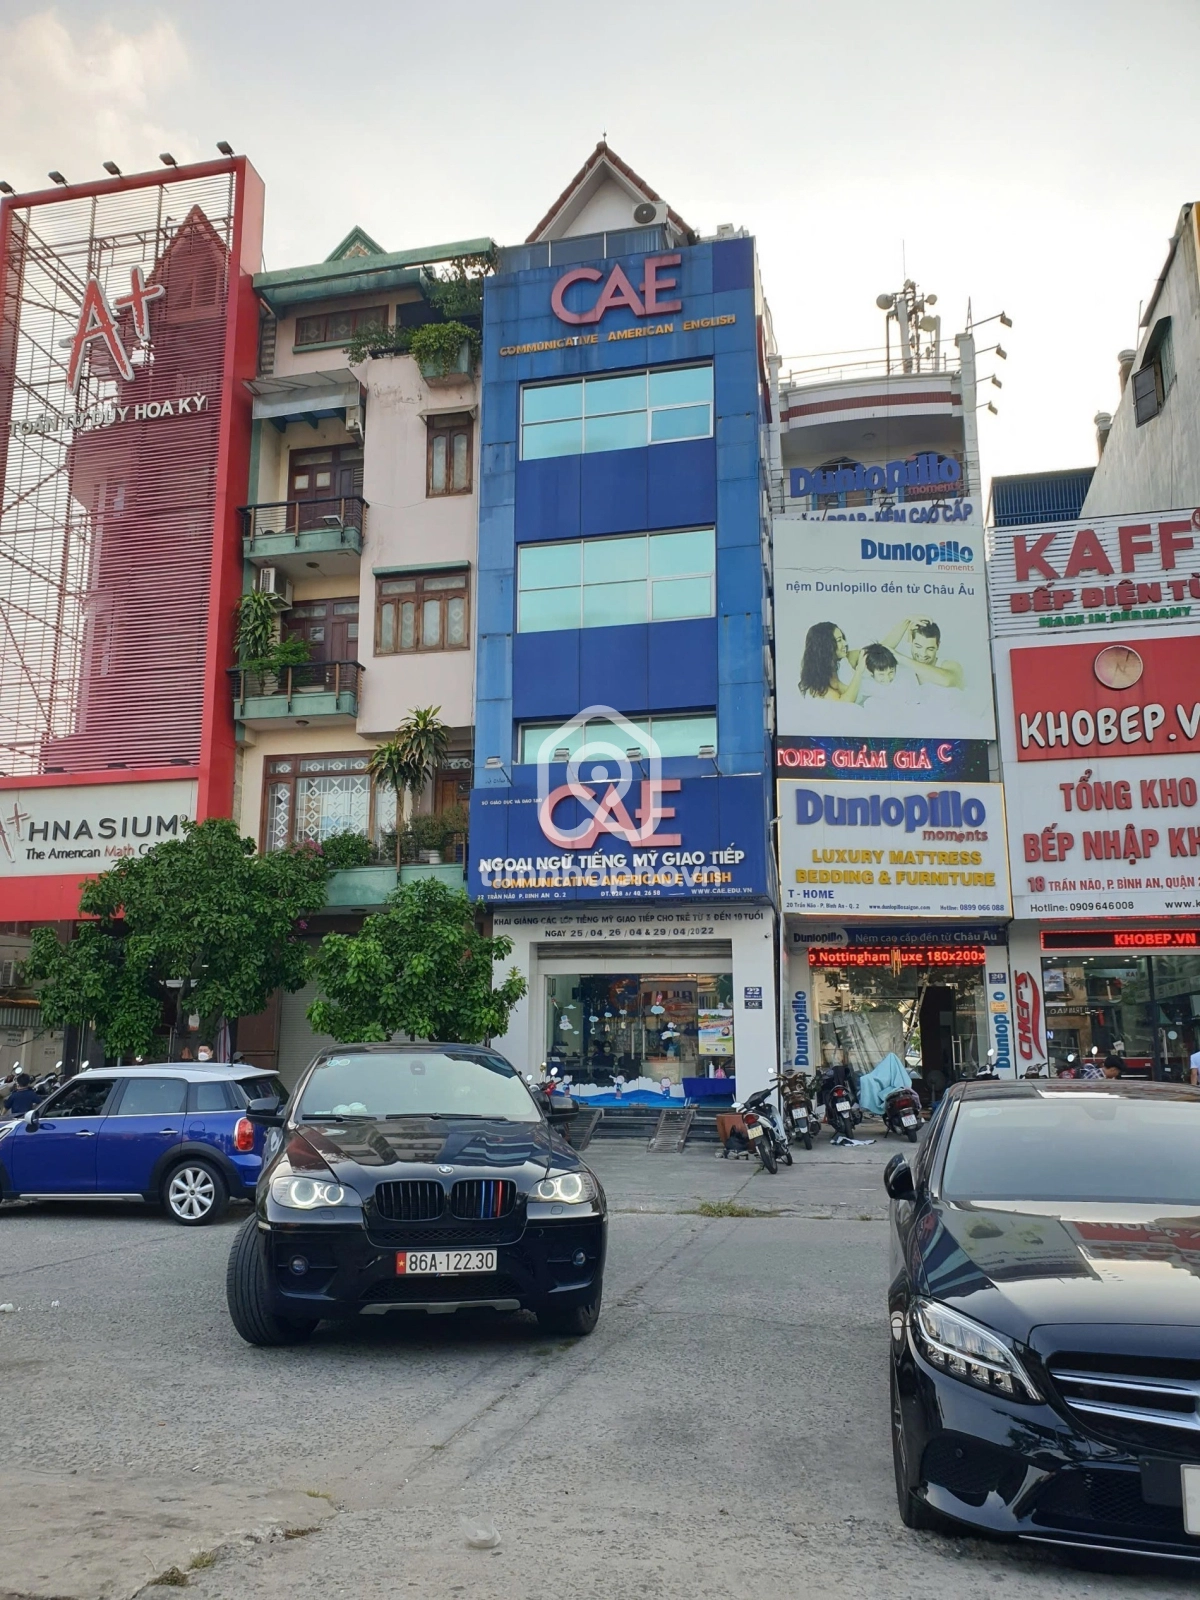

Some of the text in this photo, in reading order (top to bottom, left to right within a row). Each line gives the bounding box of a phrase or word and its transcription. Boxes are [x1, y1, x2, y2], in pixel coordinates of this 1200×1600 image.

[551, 254, 682, 326] CAE
[500, 314, 736, 357] COMMUNICATIVE AMERICAN ENGLISH
[91, 403, 130, 427] DUY
[135, 400, 173, 421] HOA
[178, 391, 206, 414] KỲ
[790, 453, 961, 498] Dunlopillo
[909, 505, 939, 524] CAO
[861, 539, 974, 565] Dunlopillo
[1013, 520, 1194, 582] KAFF
[938, 563, 975, 572] moments
[786, 580, 975, 596] nệm Dunlopillo đến từ Châu Âu
[1010, 581, 1074, 613] BẾP
[1039, 606, 1192, 627] MADE IN GERMANY
[893, 747, 932, 769] GIÁ
[1059, 768, 1197, 811] TỔNG KHO
[538, 779, 683, 850] CAE
[795, 789, 986, 833] Dunlopillo
[922, 829, 988, 843] moments
[1023, 822, 1075, 863] BẾP
[1082, 823, 1159, 866] NHẬP
[26, 848, 45, 860] The
[104, 844, 135, 857] Math
[480, 842, 745, 873] NGOẠI NGỮ TIẾNG MỸ GIAO TIẾP
[812, 850, 982, 866] LUXURY MATTRESS
[492, 875, 598, 889] COMMUNICATIVE
[601, 872, 671, 886] AMERICAN
[796, 869, 996, 887] BEDDING & FURNITURE
[1027, 876, 1046, 892] 18
[691, 887, 753, 895] WWW.CAE.EDU.VN
[788, 890, 795, 898] T
[803, 890, 835, 899] HOME
[960, 903, 976, 911] 0899
[1030, 903, 1068, 912] Hotline:
[493, 918, 511, 926] KHAI
[616, 915, 636, 923] GIAO
[657, 914, 674, 922] CHO
[794, 931, 844, 944] Dunlopillo
[880, 935, 898, 943] cao
[1114, 931, 1197, 945] KHOBEP.VN
[819, 952, 890, 963] Nottingham
[747, 987, 760, 995] 22
[792, 990, 810, 1066] Dunlopillo
[992, 991, 1011, 1069] Dunlopo
